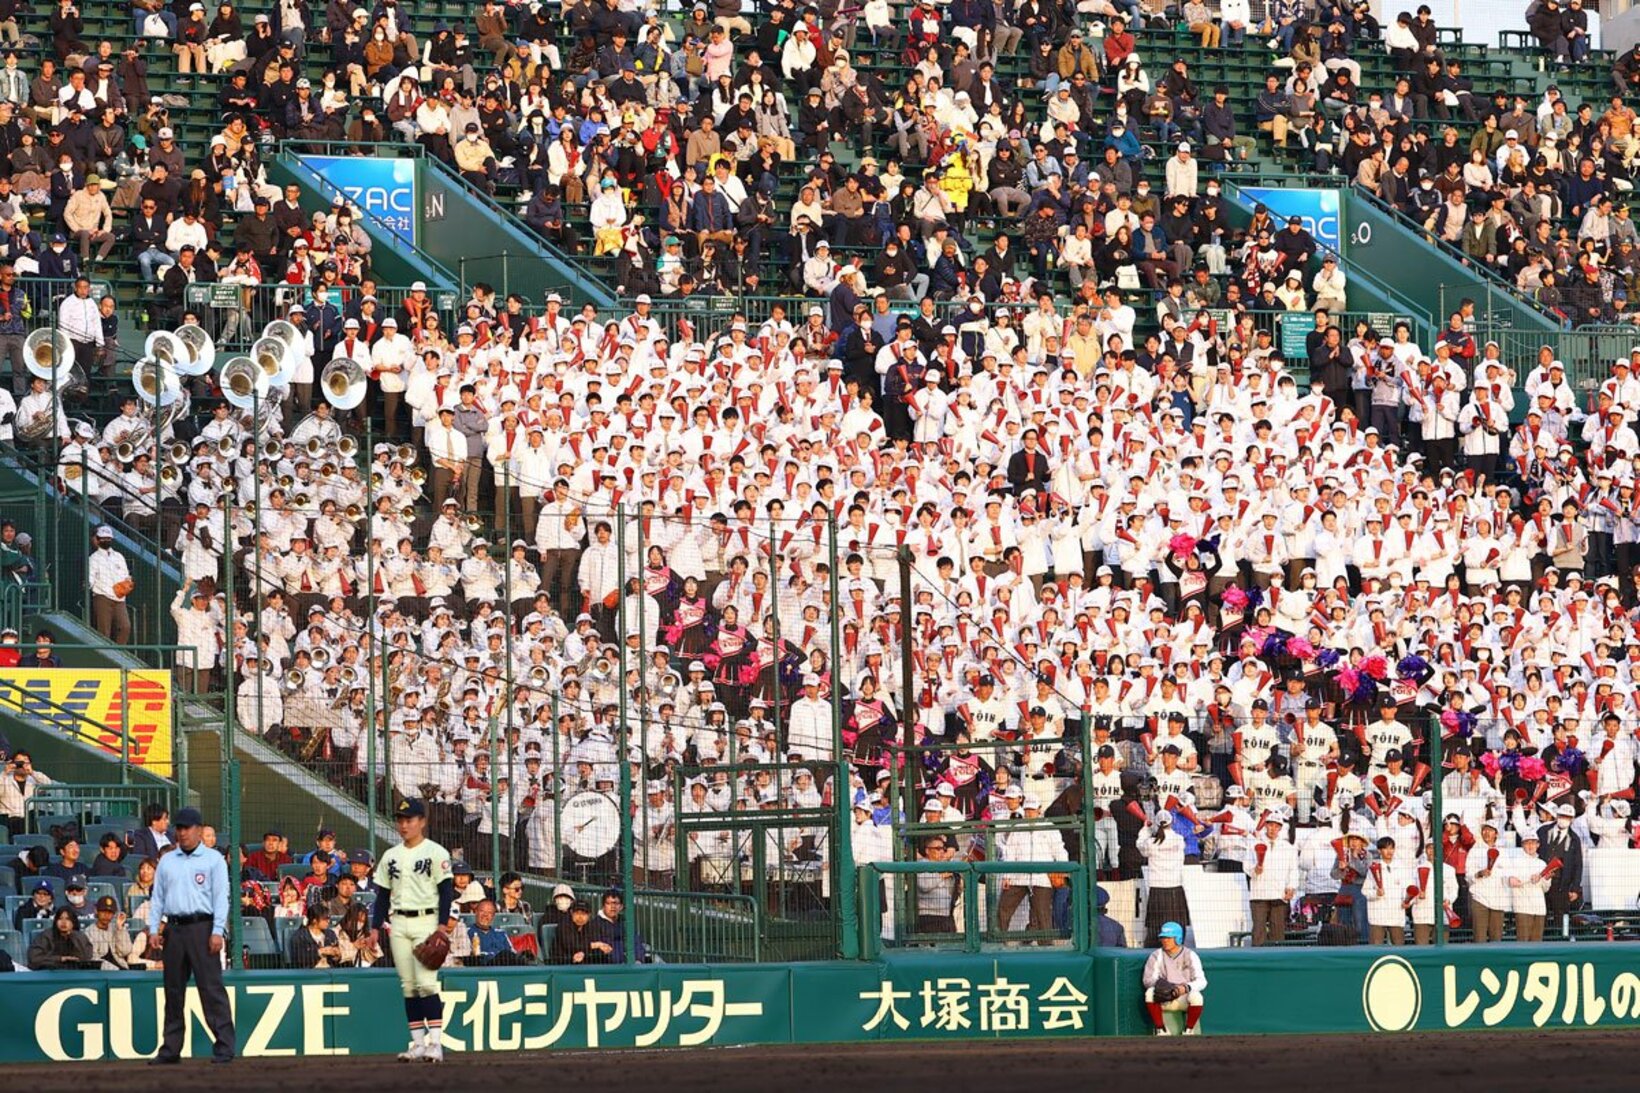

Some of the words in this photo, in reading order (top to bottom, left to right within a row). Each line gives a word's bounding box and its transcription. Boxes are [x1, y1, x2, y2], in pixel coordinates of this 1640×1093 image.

[859, 976, 1089, 1031] 大塚商会
[1443, 961, 1640, 1028] レンタルの
